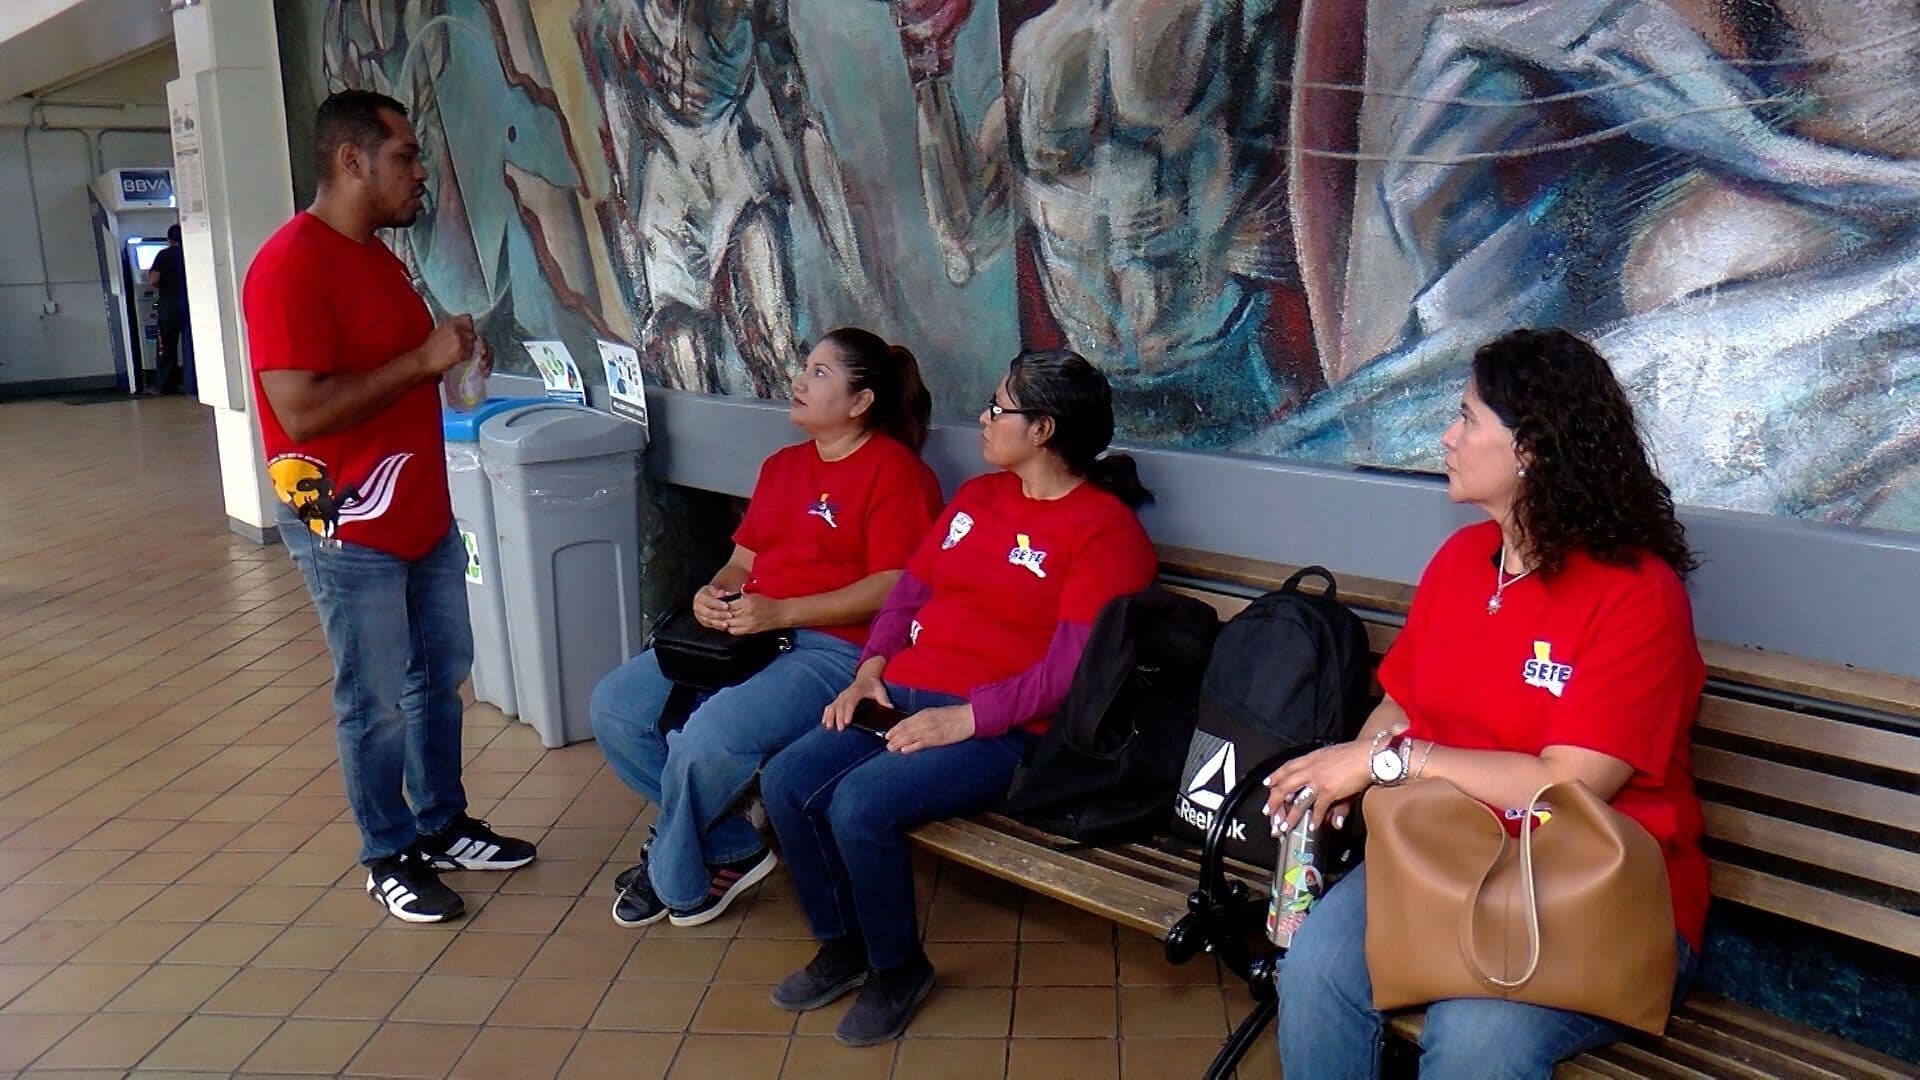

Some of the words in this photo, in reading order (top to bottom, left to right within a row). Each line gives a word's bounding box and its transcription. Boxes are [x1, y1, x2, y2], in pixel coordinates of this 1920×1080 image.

[123, 178, 170, 191] BBVA
[1525, 661, 1570, 682] SETE
[1179, 796, 1247, 841] Reek
